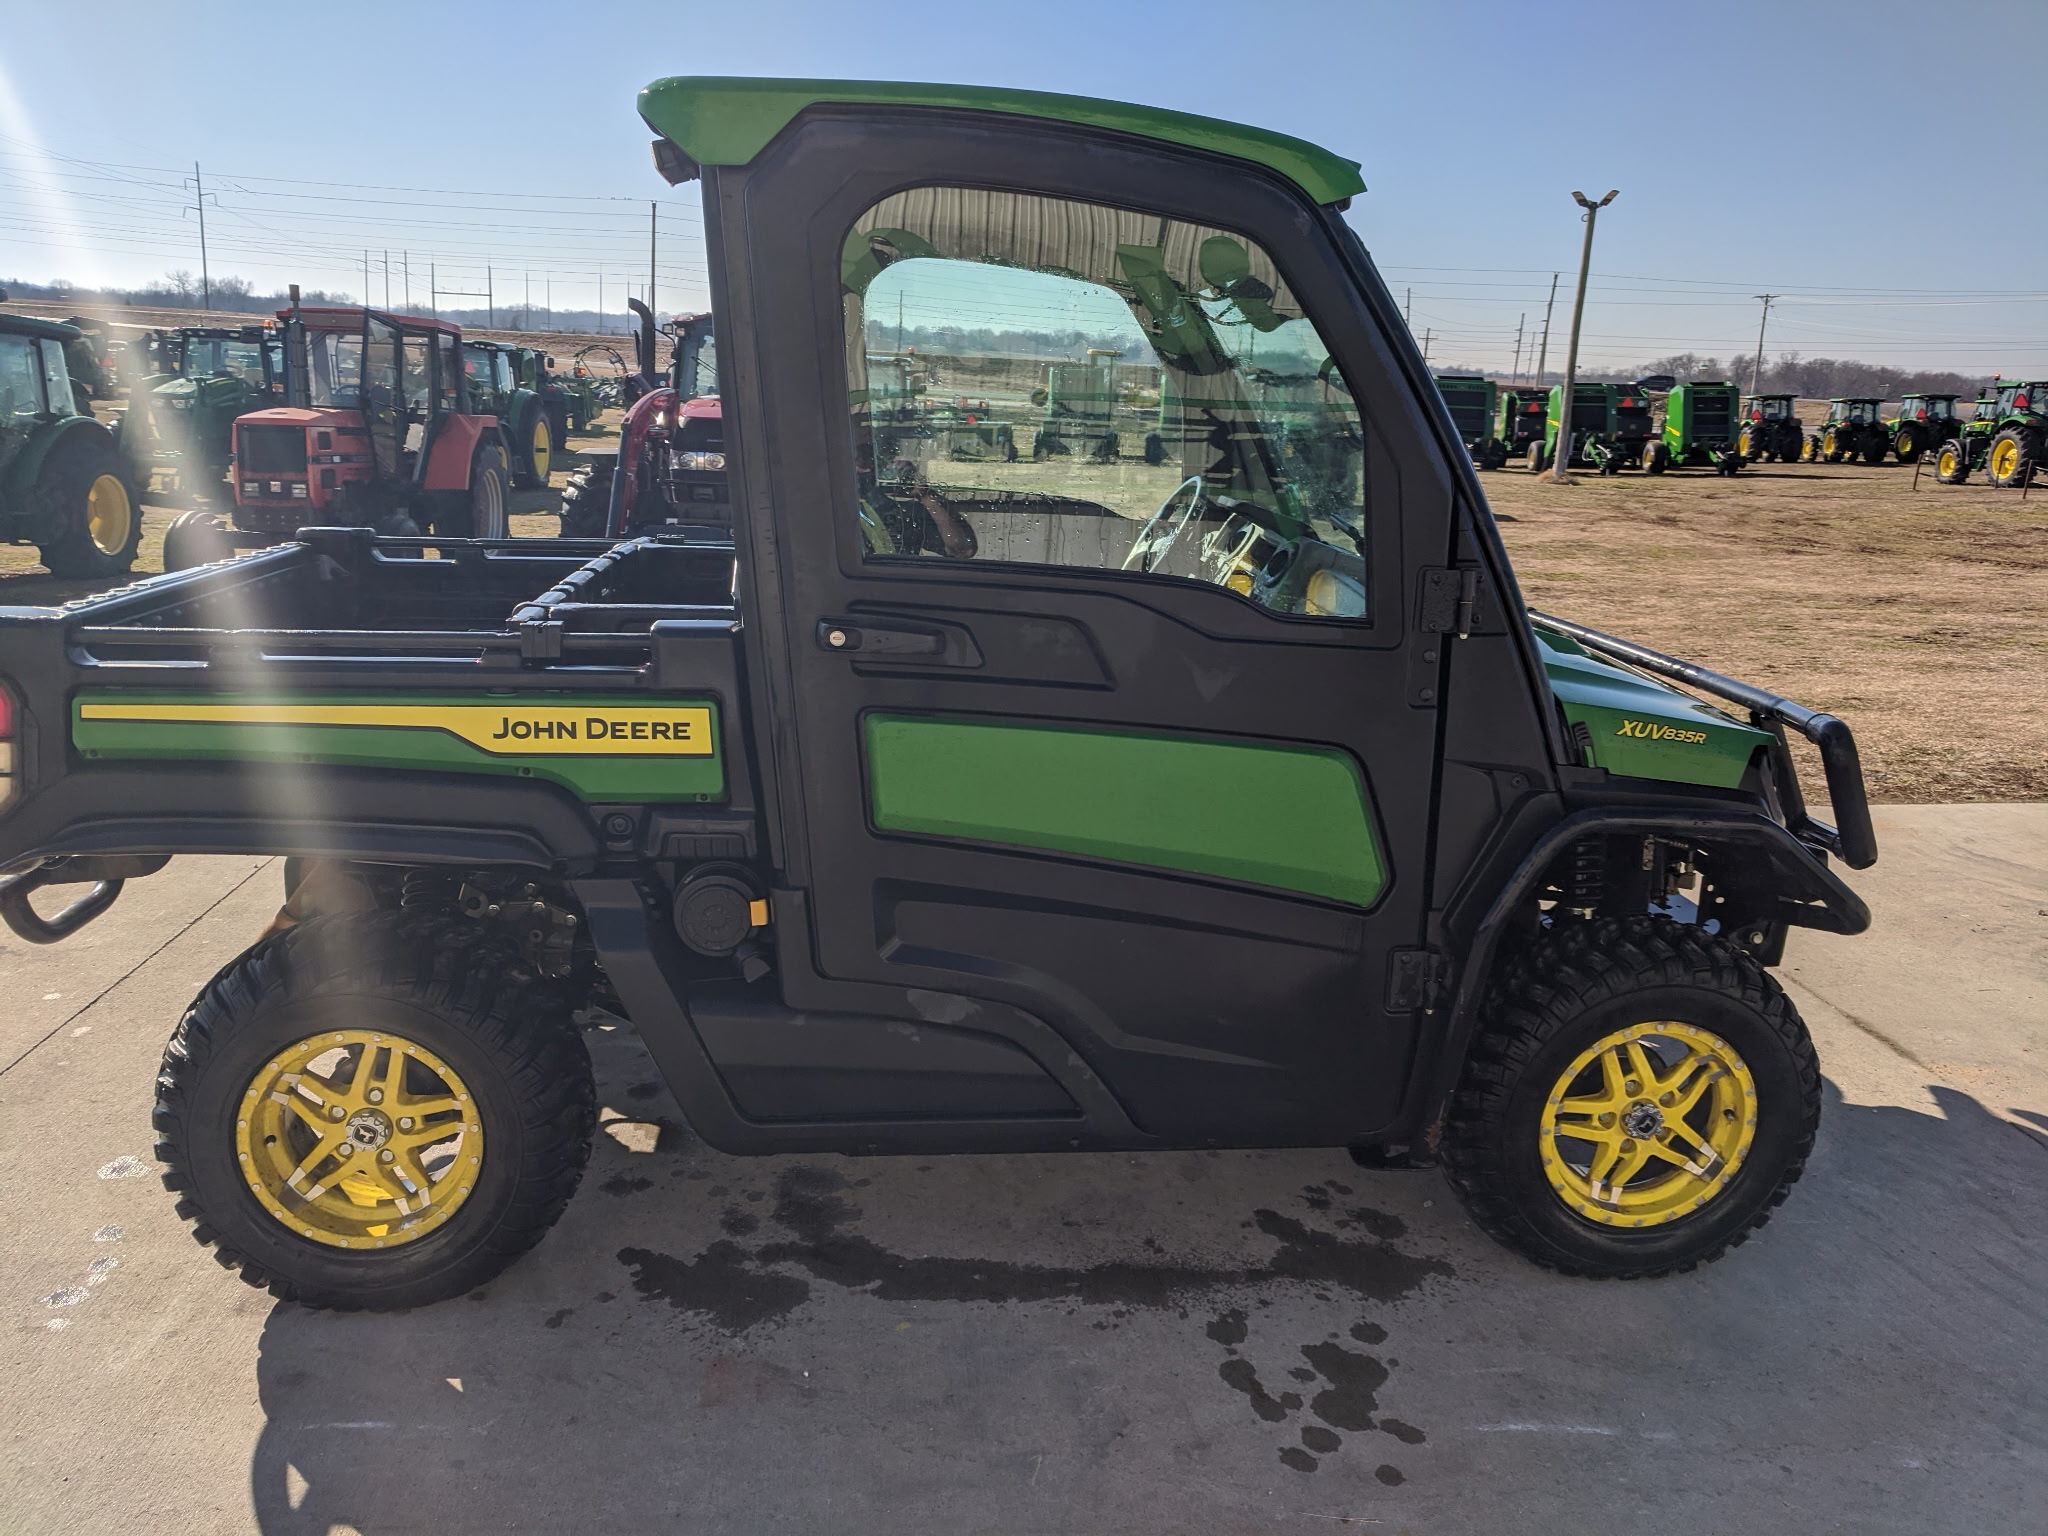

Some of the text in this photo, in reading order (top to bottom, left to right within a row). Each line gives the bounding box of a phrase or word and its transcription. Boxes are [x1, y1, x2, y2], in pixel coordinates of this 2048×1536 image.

[492, 717, 692, 741] JOHN DEERE
[1615, 719, 1707, 745] XUV835R
